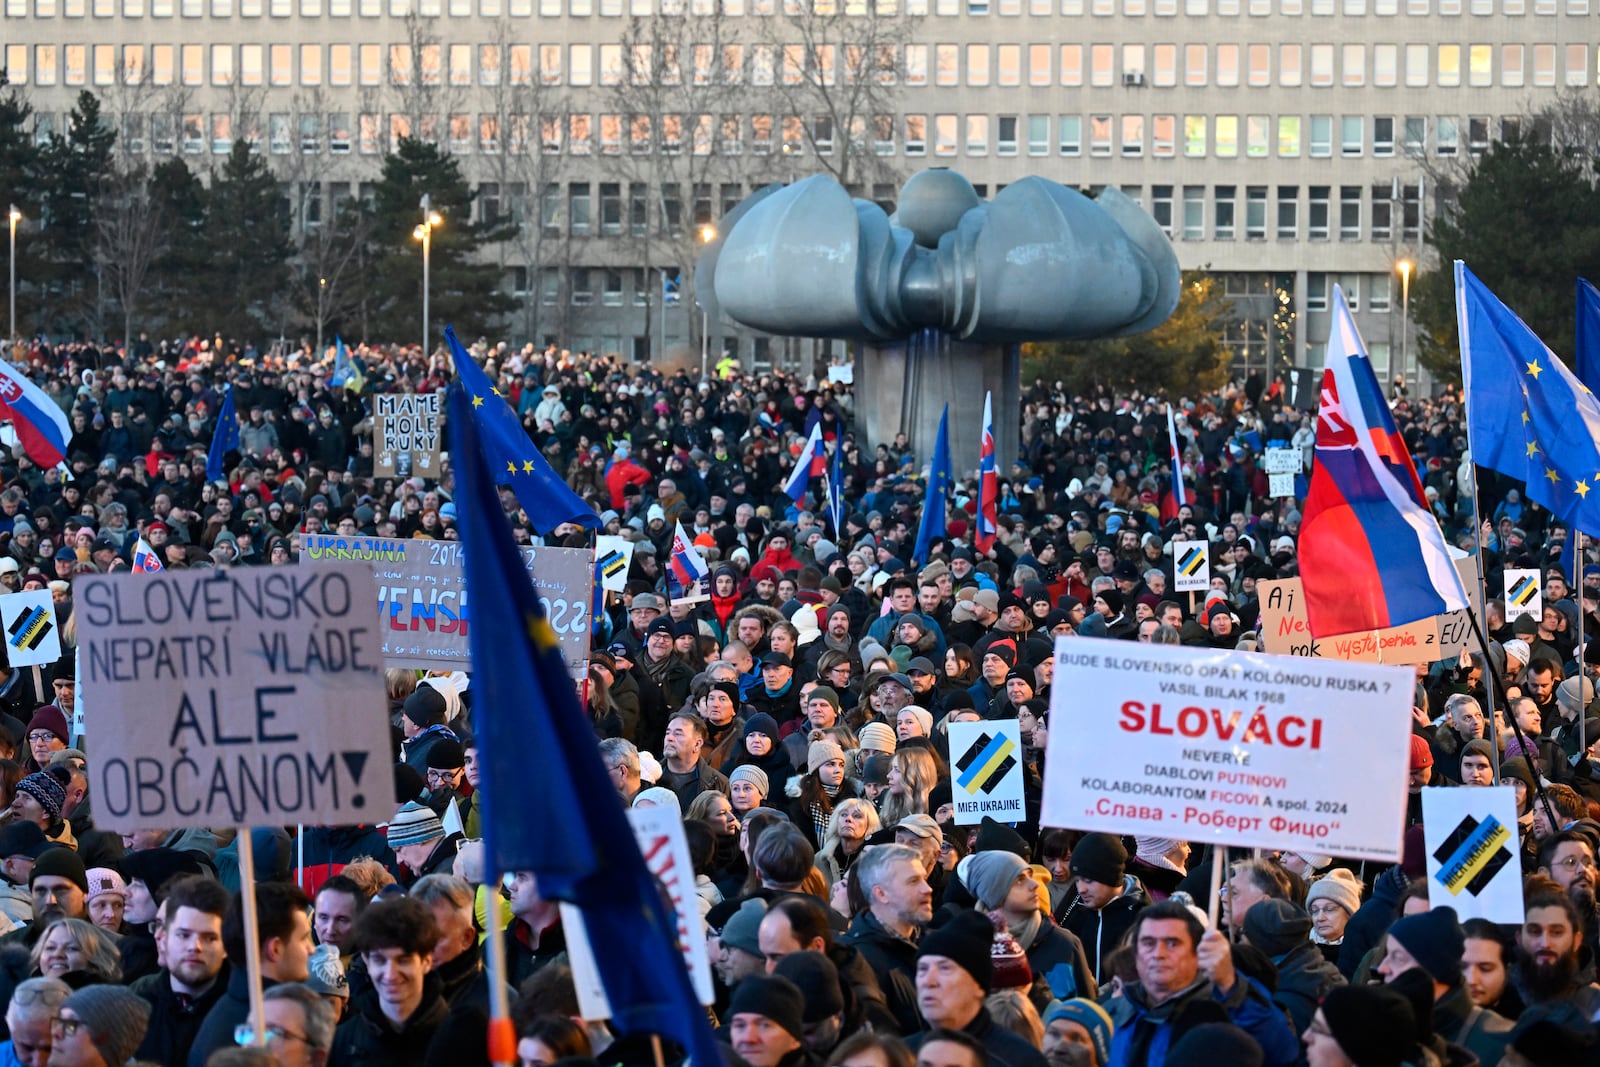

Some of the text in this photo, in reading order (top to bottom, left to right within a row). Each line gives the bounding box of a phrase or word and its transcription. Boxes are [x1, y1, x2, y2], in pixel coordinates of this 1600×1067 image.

[385, 434, 438, 452] RUKY
[307, 537, 407, 562] UKRAJINA
[84, 571, 352, 627] SLOVENSKO
[1268, 586, 1294, 612] Aj
[89, 623, 379, 683] NEPATRÍ VLÁDE,
[1290, 640, 1322, 657] rok
[1425, 634, 1434, 644] z
[1060, 652, 1099, 668] BUDE
[1104, 657, 1194, 676] SLOVENSKO
[1326, 676, 1379, 693] RUSKA
[1383, 682, 1391, 694] ?
[1159, 682, 1286, 704] VASIL BILAK 1968
[170, 686, 299, 748] ALE
[1118, 700, 1323, 749] SLOVÁCI
[102, 749, 370, 823] OBČANOM!
[1144, 764, 1287, 789] DIABLOVI PUTINOVI
[958, 799, 1021, 813] MIER UKRAJINE
[1081, 778, 1348, 815] KOLABORANTOM FICOVI A spol. 2024
[1085, 798, 1163, 821] „Слава
[1184, 806, 1262, 833] Роберт
[1442, 821, 1505, 889] MIER UKRAJINE
